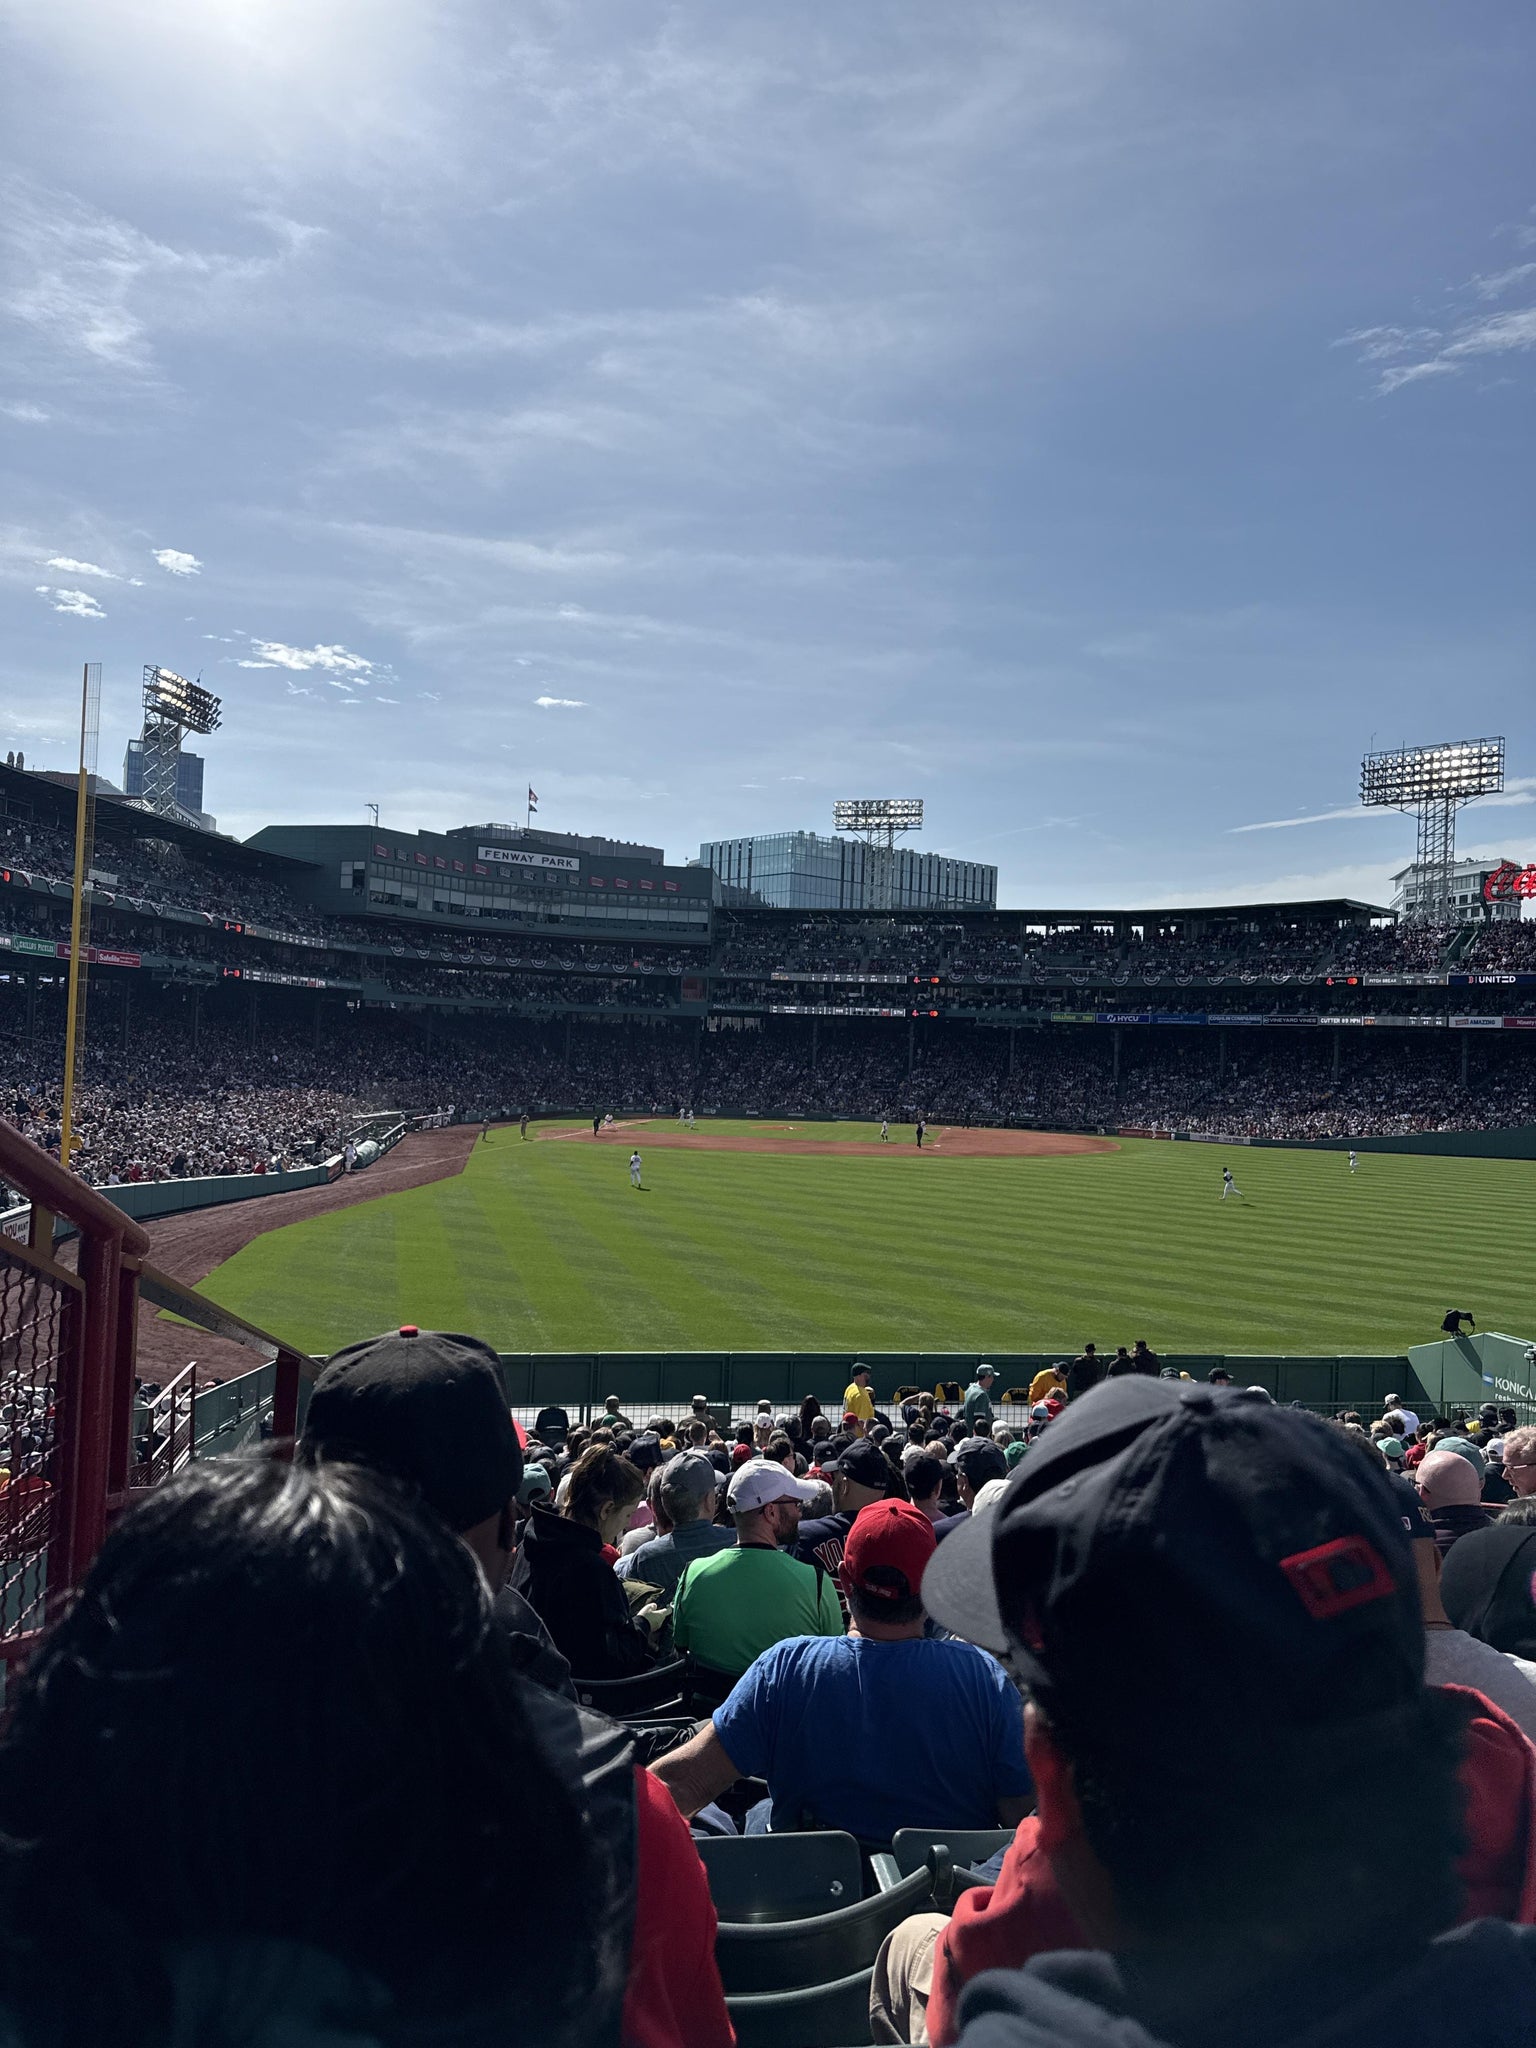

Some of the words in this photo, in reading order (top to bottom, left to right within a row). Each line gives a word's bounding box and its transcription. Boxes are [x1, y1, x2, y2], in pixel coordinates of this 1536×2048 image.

[484, 849, 535, 863] FENWAY
[541, 856, 574, 869] PARK
[1478, 975, 1517, 984] UNITED
[5, 1222, 18, 1238] YOU
[1495, 1376, 1534, 1400] KONICA
